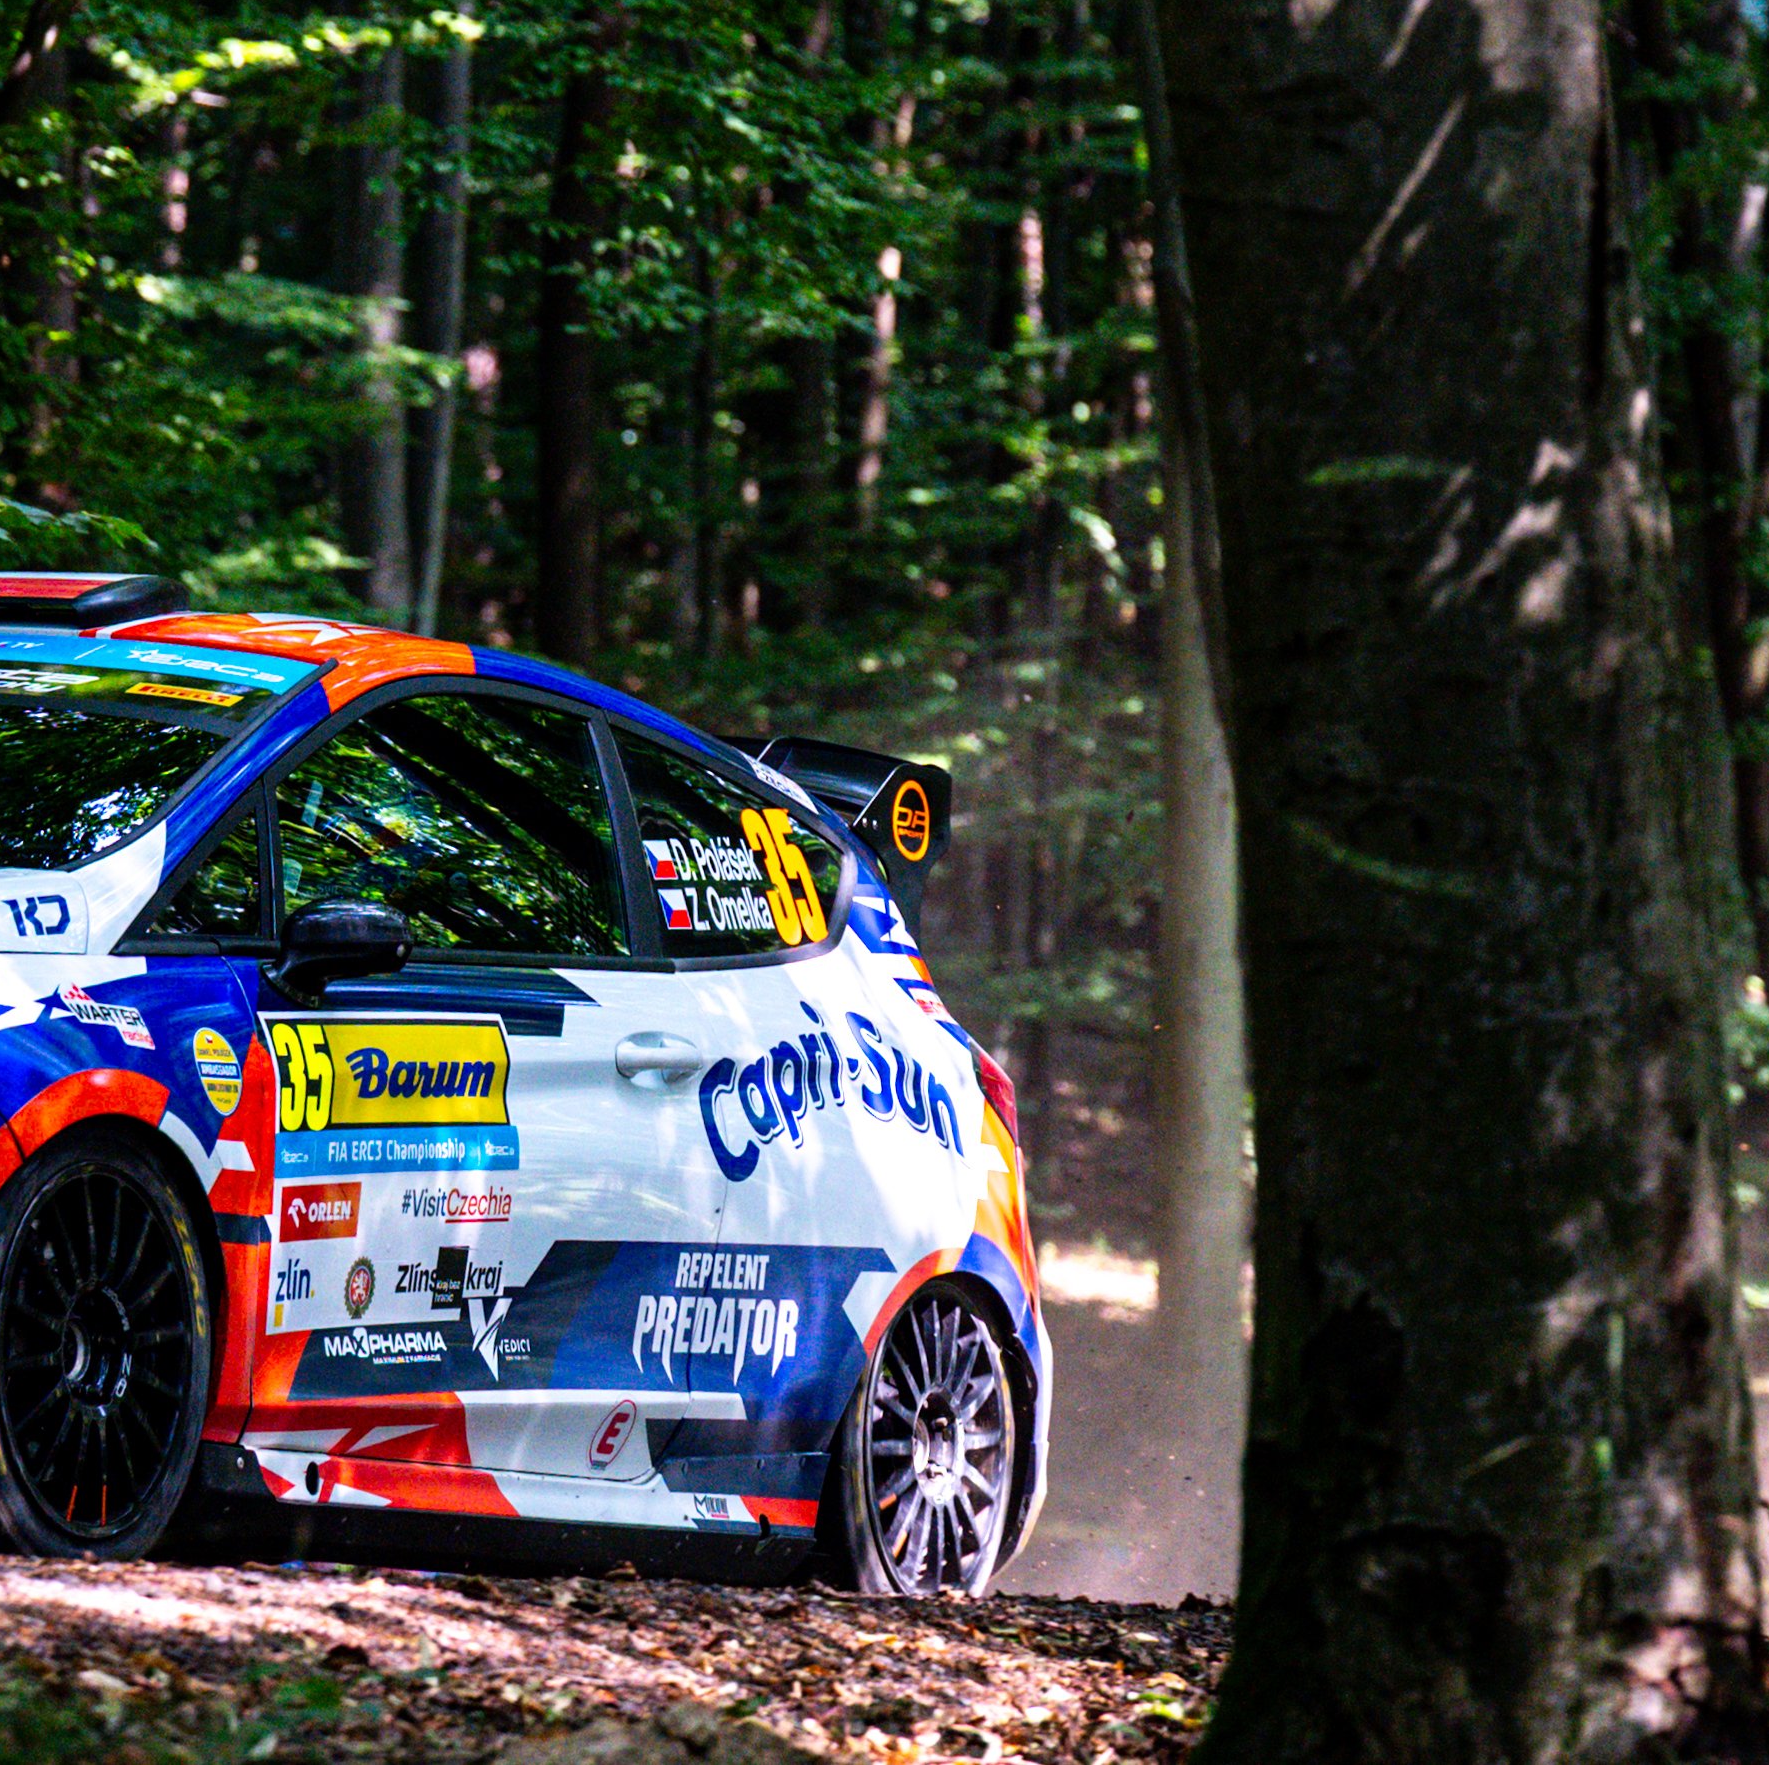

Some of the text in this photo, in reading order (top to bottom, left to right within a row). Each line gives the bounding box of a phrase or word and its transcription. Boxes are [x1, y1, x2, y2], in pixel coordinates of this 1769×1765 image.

[669, 836, 763, 881] D. Polášek
[740, 807, 829, 945] 35
[684, 886, 775, 931] Z. Omelka
[69, 1003, 145, 1028] WARTER
[271, 1022, 334, 1132] 35
[345, 1046, 496, 1099] Barum
[328, 1137, 467, 1166] FIA ERC3 Championship
[307, 1199, 352, 1224] ORLEN
[402, 1186, 512, 1218] #VisitCzechia
[466, 1260, 503, 1296] kraj
[676, 1251, 770, 1291] REPELENT
[323, 1326, 448, 1359] MAXPHARMA
[632, 1294, 800, 1387] PREDATOR
